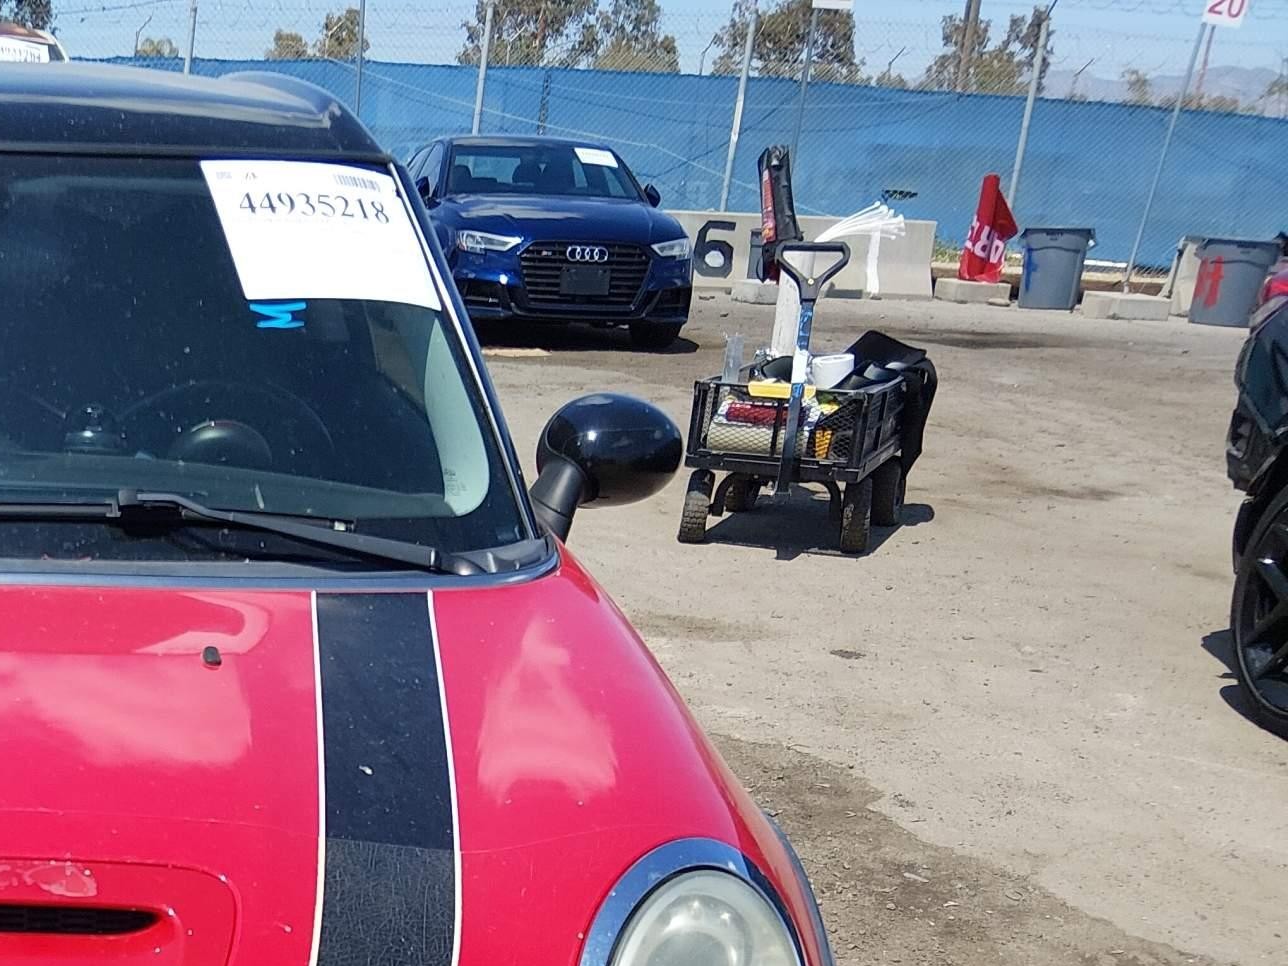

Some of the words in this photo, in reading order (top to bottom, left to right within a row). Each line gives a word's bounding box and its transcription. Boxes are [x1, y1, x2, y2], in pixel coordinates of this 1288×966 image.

[1208, 0, 1245, 18] 20
[239, 192, 390, 224] 44935218
[693, 220, 736, 279] 6
